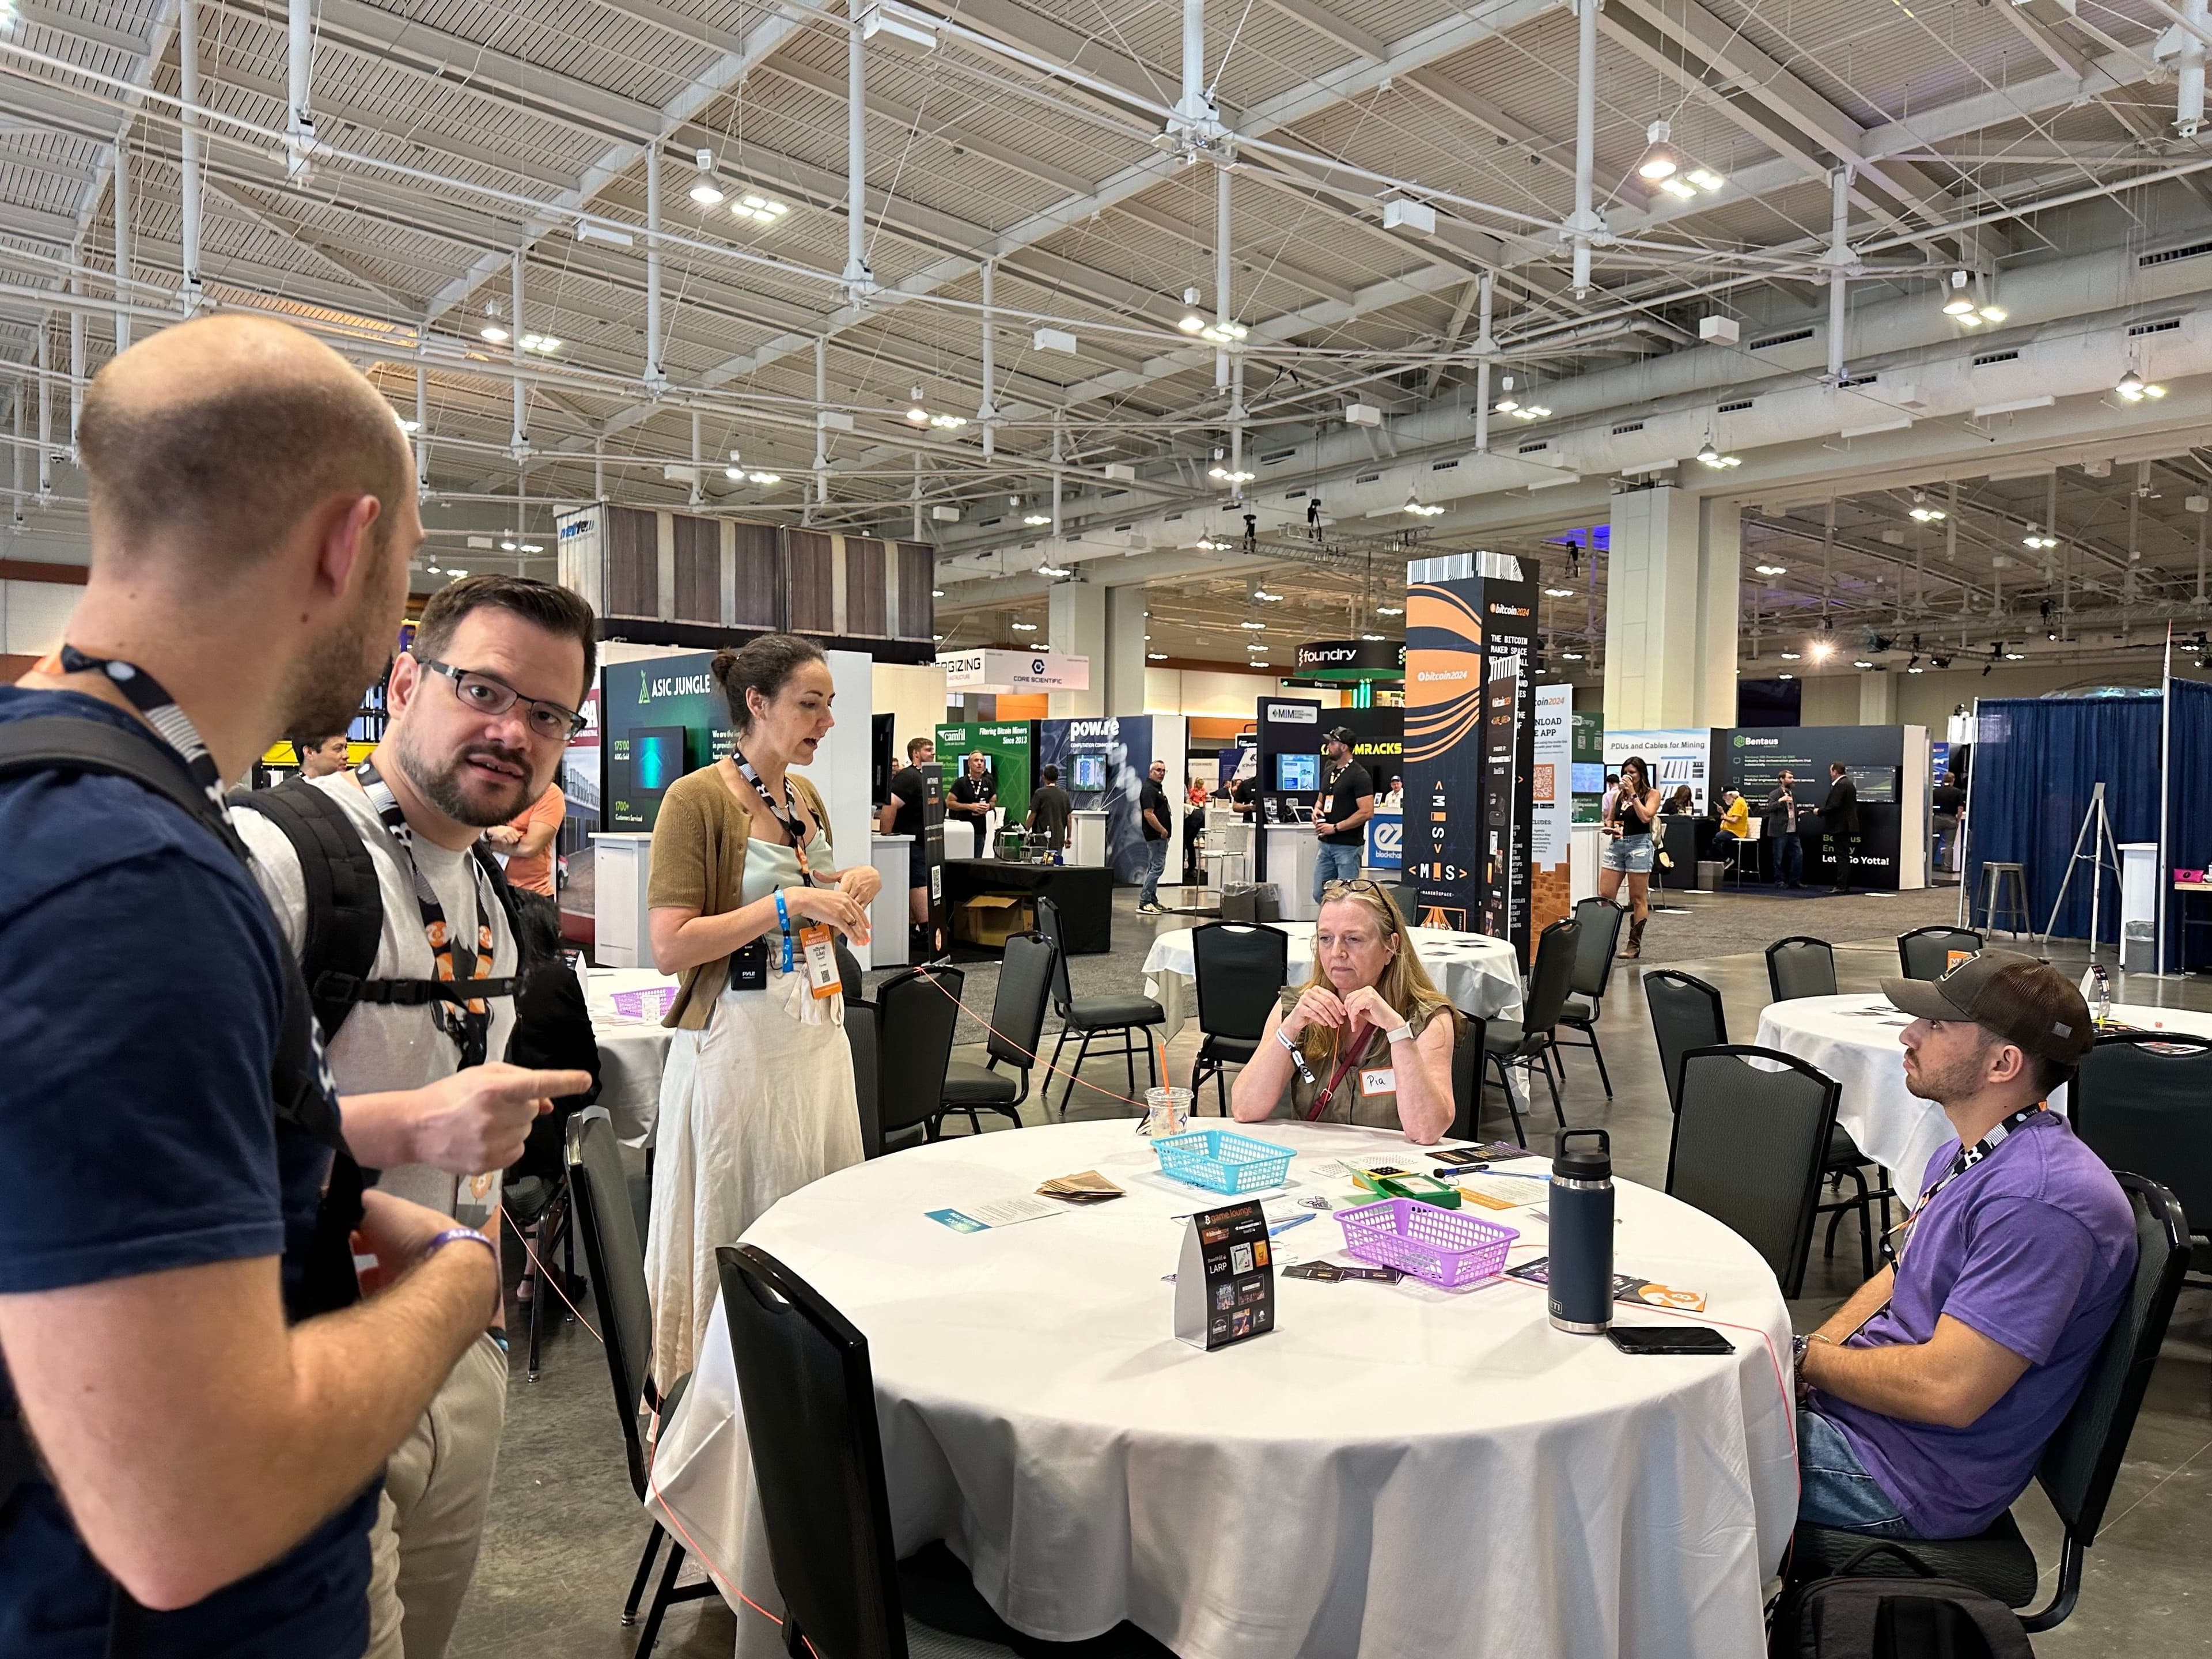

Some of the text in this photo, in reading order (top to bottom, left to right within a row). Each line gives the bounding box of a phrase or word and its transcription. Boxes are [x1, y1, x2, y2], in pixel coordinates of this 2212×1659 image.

[1495, 604, 1529, 617] bitcoin2024
[1491, 634, 1528, 645] THE BITCOIN
[1304, 649, 1357, 662] foundry
[1491, 645, 1528, 656] MAKER SPACE
[1424, 671, 1467, 681] bitcoin2024
[652, 674, 710, 697] ASIC JUNGLE
[1278, 709, 1294, 719] MIM
[1535, 718, 1562, 726] NLOAD
[944, 728, 965, 741] camfil
[980, 728, 997, 736] Filtering
[997, 727, 1011, 735] Bitcoin
[1070, 721, 1119, 741] pow.re
[1016, 736, 1027, 744] 2013
[1745, 737, 1779, 745] Bentaus
[615, 801, 629, 811] 1700+
[1861, 857, 1889, 865] Yotta!
[1367, 1075, 1386, 1087] Pia
[1211, 1206, 1253, 1224] game lounge
[1210, 1262, 1227, 1274] LARP
[1550, 1300, 1560, 1312] ETI
